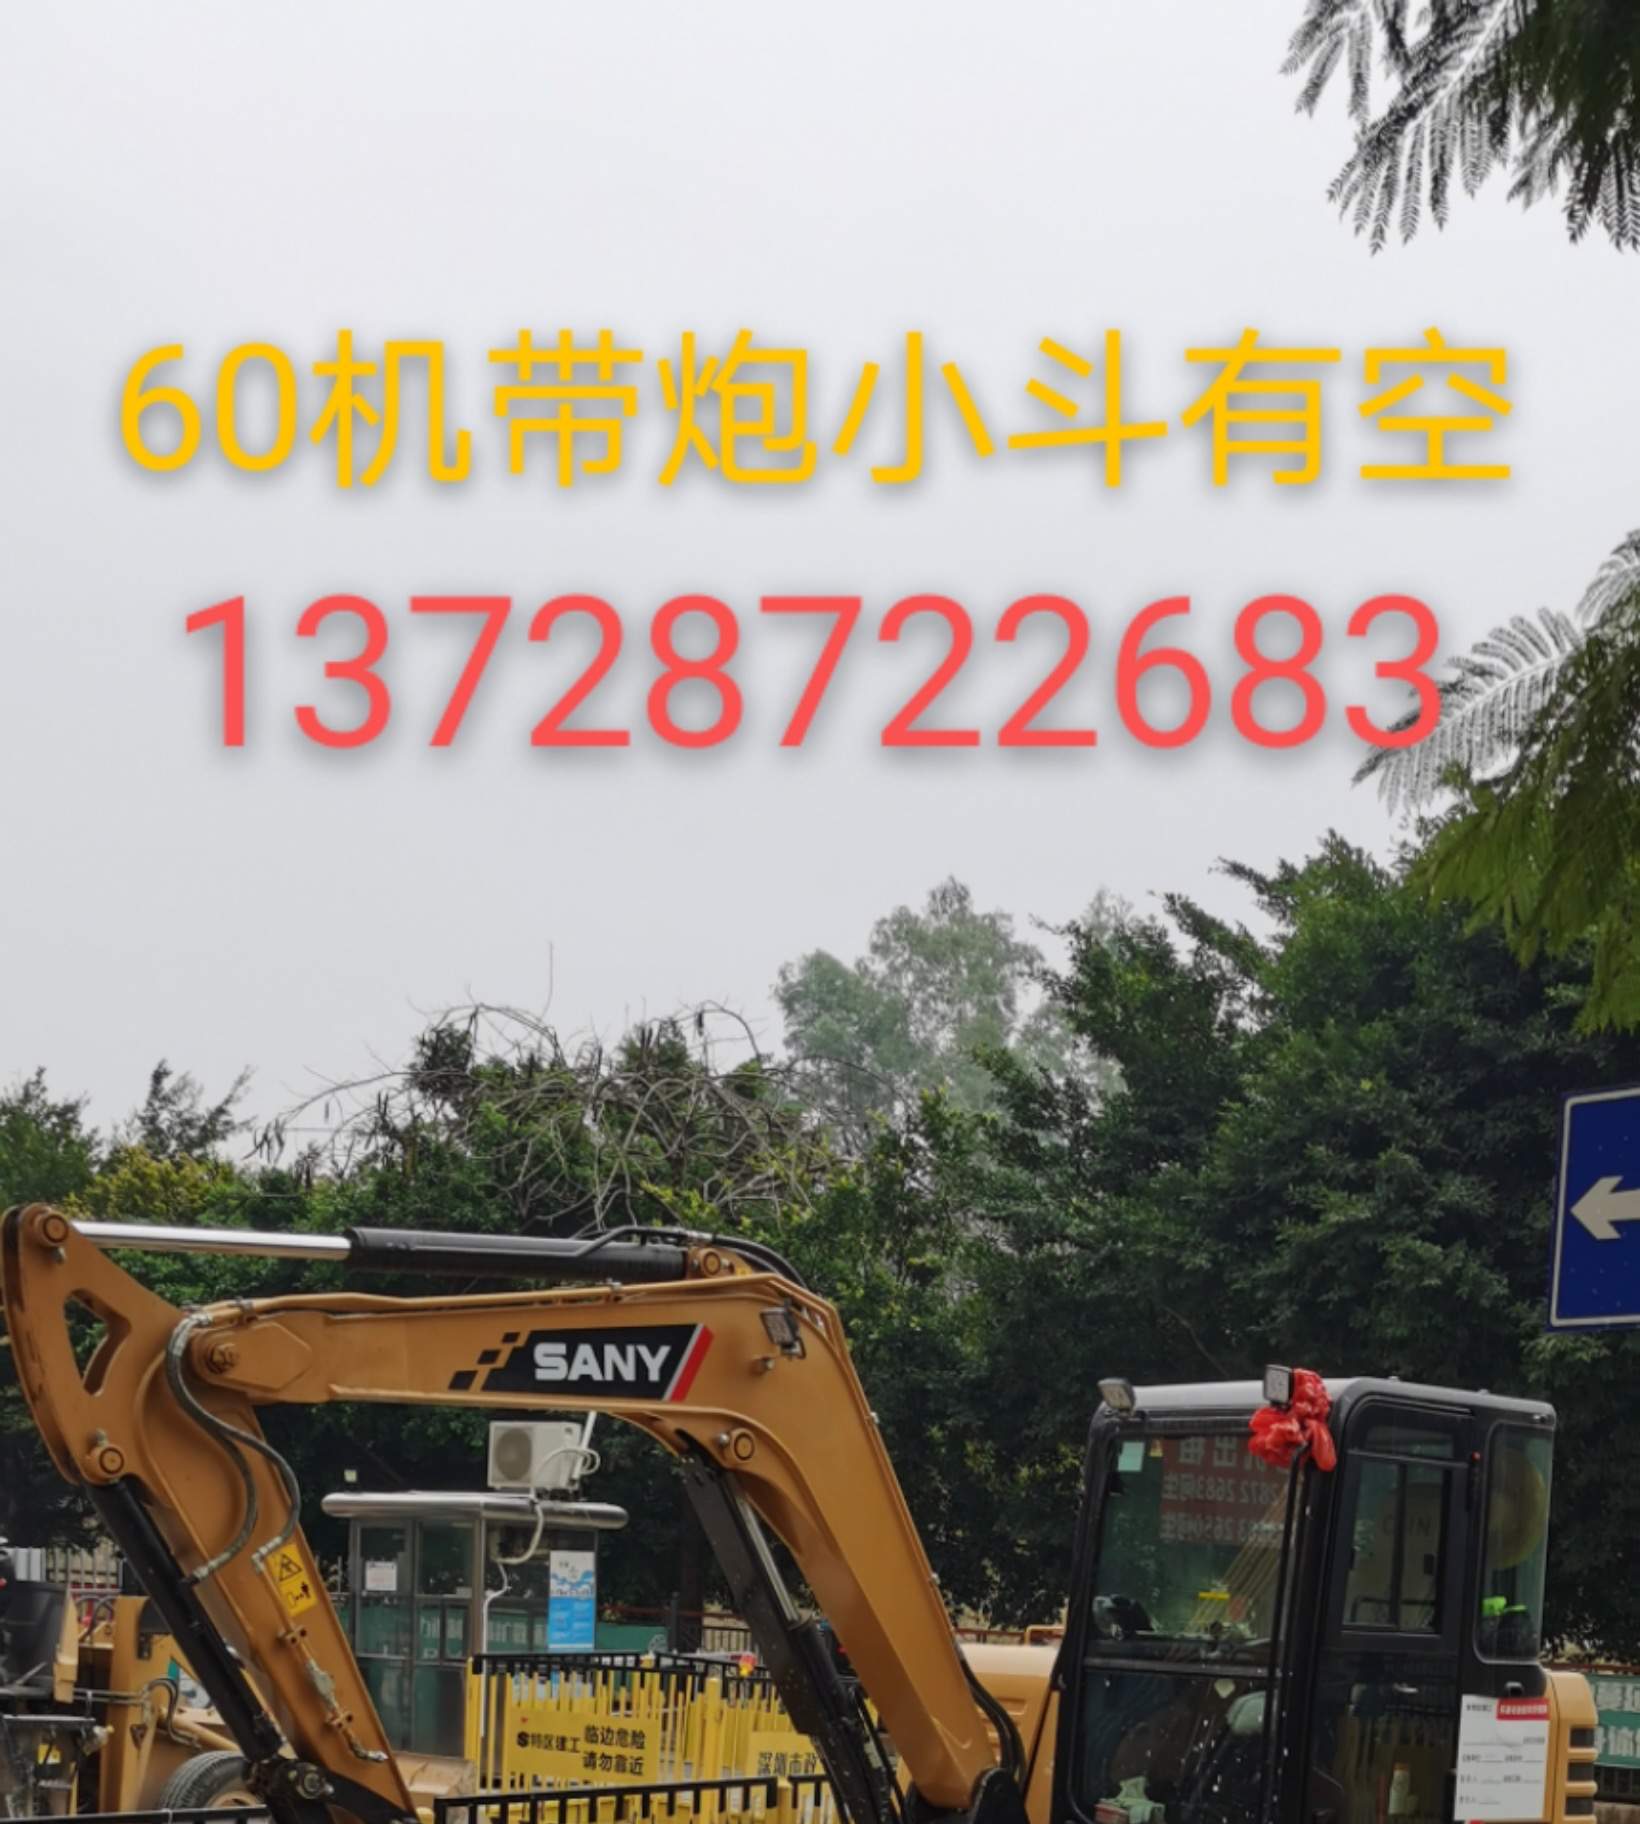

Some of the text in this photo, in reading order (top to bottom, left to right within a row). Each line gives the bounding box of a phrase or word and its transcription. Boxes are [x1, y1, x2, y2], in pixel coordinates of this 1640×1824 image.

[533, 1342, 671, 1382] SANY
[584, 1724, 646, 1750] 临边危险
[582, 1751, 645, 1776] 请勿靠近
